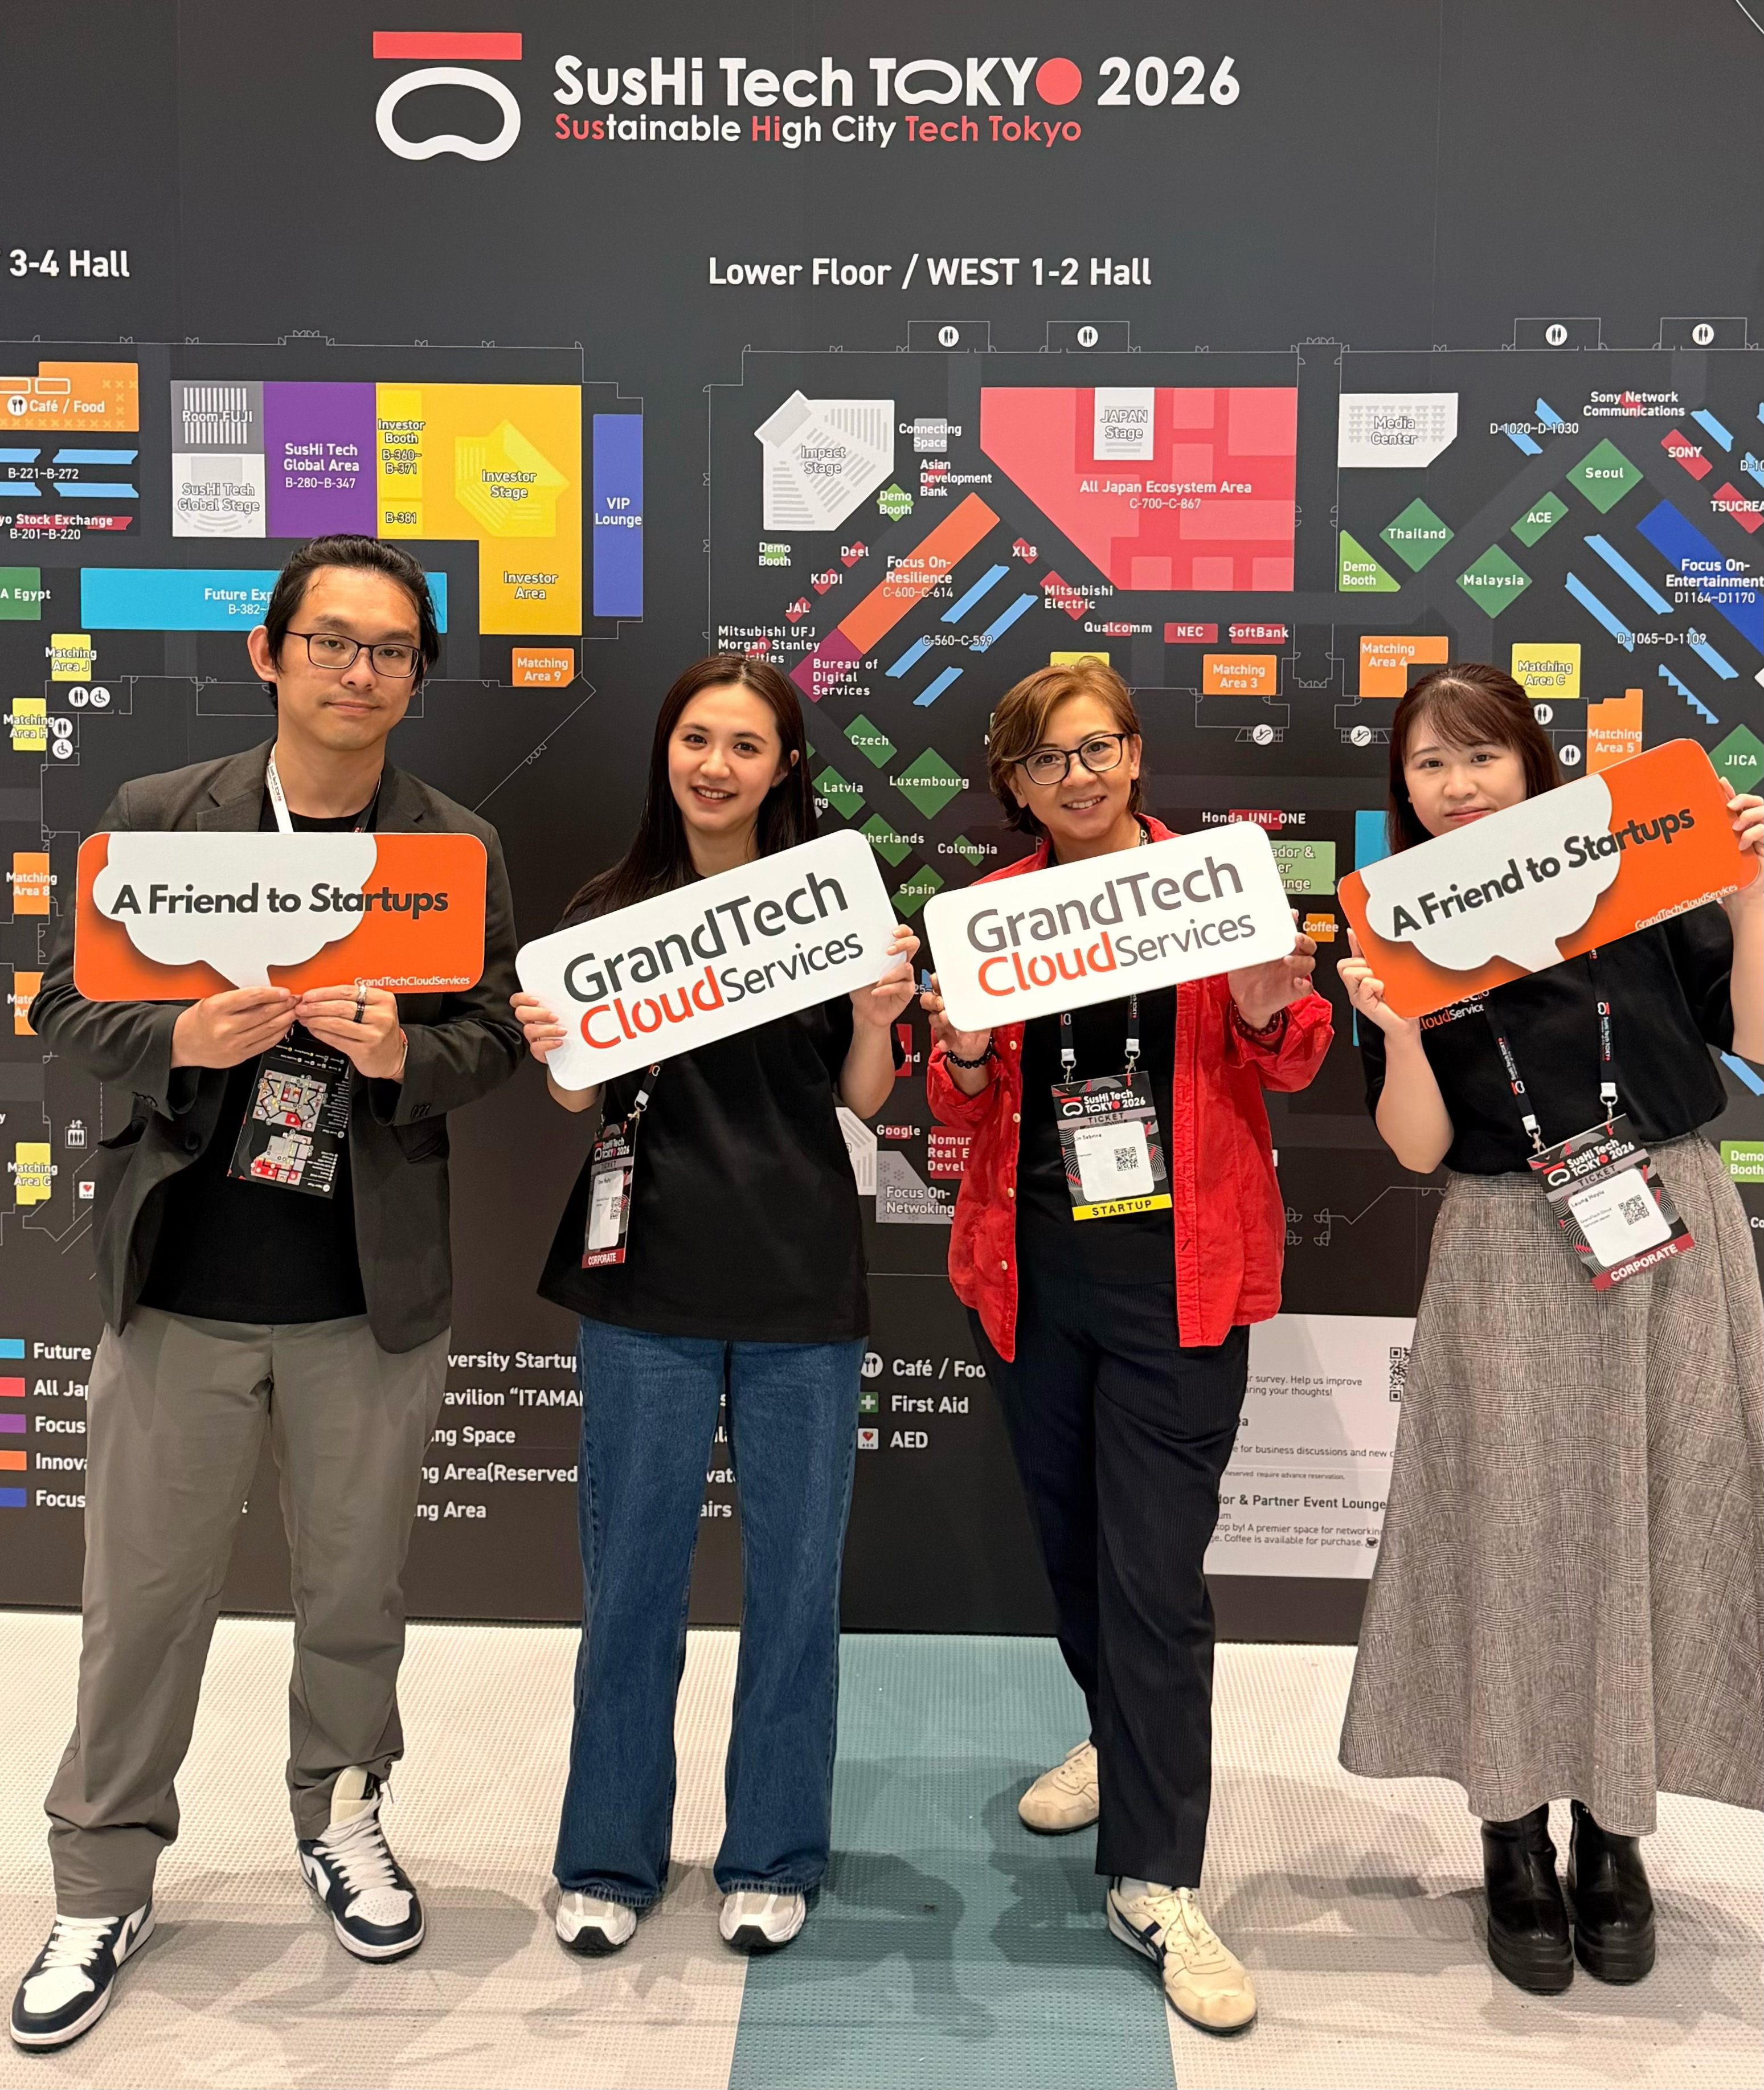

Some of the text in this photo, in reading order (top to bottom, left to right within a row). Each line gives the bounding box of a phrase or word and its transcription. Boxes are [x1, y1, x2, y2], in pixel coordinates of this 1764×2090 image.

[553, 55, 705, 107] SusHi
[718, 58, 853, 107] Tech
[1098, 56, 1239, 106] 2026
[555, 114, 1082, 148] Sustainable High City Tech Tokyo
[10, 250, 130, 277] 3-4 Hall
[708, 257, 1152, 287] Lower Floor WEST 1-2 Hall
[1591, 392, 1678, 404] Sony Network
[30, 400, 105, 413] Café Food
[1583, 406, 1685, 416] Communications
[1100, 410, 1147, 423] JAPAN
[1374, 416, 1415, 429] Media
[899, 424, 961, 436] Connecting
[1105, 427, 1143, 441] Stage
[914, 437, 946, 448] Space
[1372, 433, 1417, 445] Center
[285, 443, 357, 456] SusHi Tech
[801, 446, 845, 460] Impact
[1668, 447, 1701, 457] SONY
[284, 459, 359, 472] Global Area
[804, 462, 841, 476] Stage
[920, 460, 951, 469] Asian
[482, 471, 537, 482] Investor
[920, 473, 992, 484] Development
[1586, 468, 1623, 478] Seoul
[490, 486, 527, 500] Stage
[920, 486, 947, 496] Bank
[1080, 481, 1251, 496] All Japan Ecosystem Area
[880, 492, 911, 501] Demo
[607, 498, 630, 509] VIP
[879, 505, 911, 514] Booth
[17, 514, 50, 525] Stock
[55, 515, 113, 527] Exchange
[595, 513, 641, 527] Lounge
[1527, 513, 1552, 523] ACE
[1389, 529, 1446, 539] Thailand
[841, 547, 869, 556] Deel
[1012, 546, 1037, 557] XL8
[887, 557, 951, 568] Focus On-
[1343, 562, 1376, 572] Demo
[1681, 559, 1750, 571] Focus On-
[811, 574, 842, 584] KDDI
[886, 572, 952, 583] Resilience
[1343, 575, 1376, 585] Booth
[1464, 575, 1524, 587] Malaysia
[1666, 575, 1764, 588] Entertainment
[15, 589, 51, 601] Egypt
[1045, 586, 1113, 596] Mitsubishi
[786, 603, 809, 612] JAL
[1045, 599, 1095, 610] Electric
[718, 626, 815, 636] Mitsubishi UFJ
[1084, 622, 1152, 633] Qualcomm
[1177, 627, 1204, 637] NEC
[1229, 627, 1288, 638] SoftBank
[718, 640, 820, 652] Morgan Stanley
[1362, 644, 1415, 657] Matching
[517, 657, 568, 671] Matching
[813, 659, 878, 669] Bureau of
[1369, 657, 1406, 668] Area 4
[524, 671, 561, 681] Area 9
[1213, 664, 1265, 677] Matching
[813, 672, 857, 684] Digital
[1220, 678, 1257, 689] Area 3
[813, 685, 870, 696] Services
[852, 735, 889, 745] Czech
[1725, 755, 1757, 766] JICA
[824, 783, 863, 793] Latvia
[890, 776, 969, 789] Luxembourg
[1202, 812, 1305, 824] Honda UNI-ONE
[938, 844, 997, 854] Colombia
[1393, 808, 1695, 937] A Friend to Startups
[900, 885, 935, 896] Spain
[111, 883, 448, 919] A Friend to Startups
[967, 856, 1243, 953] GrandTech
[1635, 884, 1738, 930] GrandTechCloudServices
[1303, 922, 1339, 932] Coffee
[564, 872, 848, 1003] GrandTech
[978, 914, 1255, 996] CloudServices
[354, 976, 470, 987] GrandTechCloudServices
[580, 933, 863, 1049] CloudServices
[1111, 1090, 1133, 1100] Tech
[1122, 1097, 1145, 1108] 2026
[1088, 1113, 1124, 1123] TICKET
[877, 1125, 920, 1138] Google
[887, 1186, 951, 1199] Focus On-
[887, 1201, 955, 1217] Netwoking
[1092, 1200, 1152, 1216] STARTUP
[588, 1253, 616, 1265] CORPORATE
[1611, 1244, 1678, 1282] CORPORATE
[34, 1343, 91, 1360] Future
[893, 1359, 932, 1376] Café
[1291, 1376, 1310, 1384] Help
[1327, 1378, 1362, 1386] improve
[1291, 1388, 1332, 1397] thoughts!
[892, 1396, 968, 1413] First Aid
[35, 1416, 85, 1433] Focus
[890, 1432, 928, 1448] AED
[1256, 1445, 1294, 1454] business
[1297, 1447, 1348, 1456] discussions
[1253, 1495, 1386, 1511] Partner Event Lounge
[1225, 1535, 1363, 1547] Coffee available purchase.
